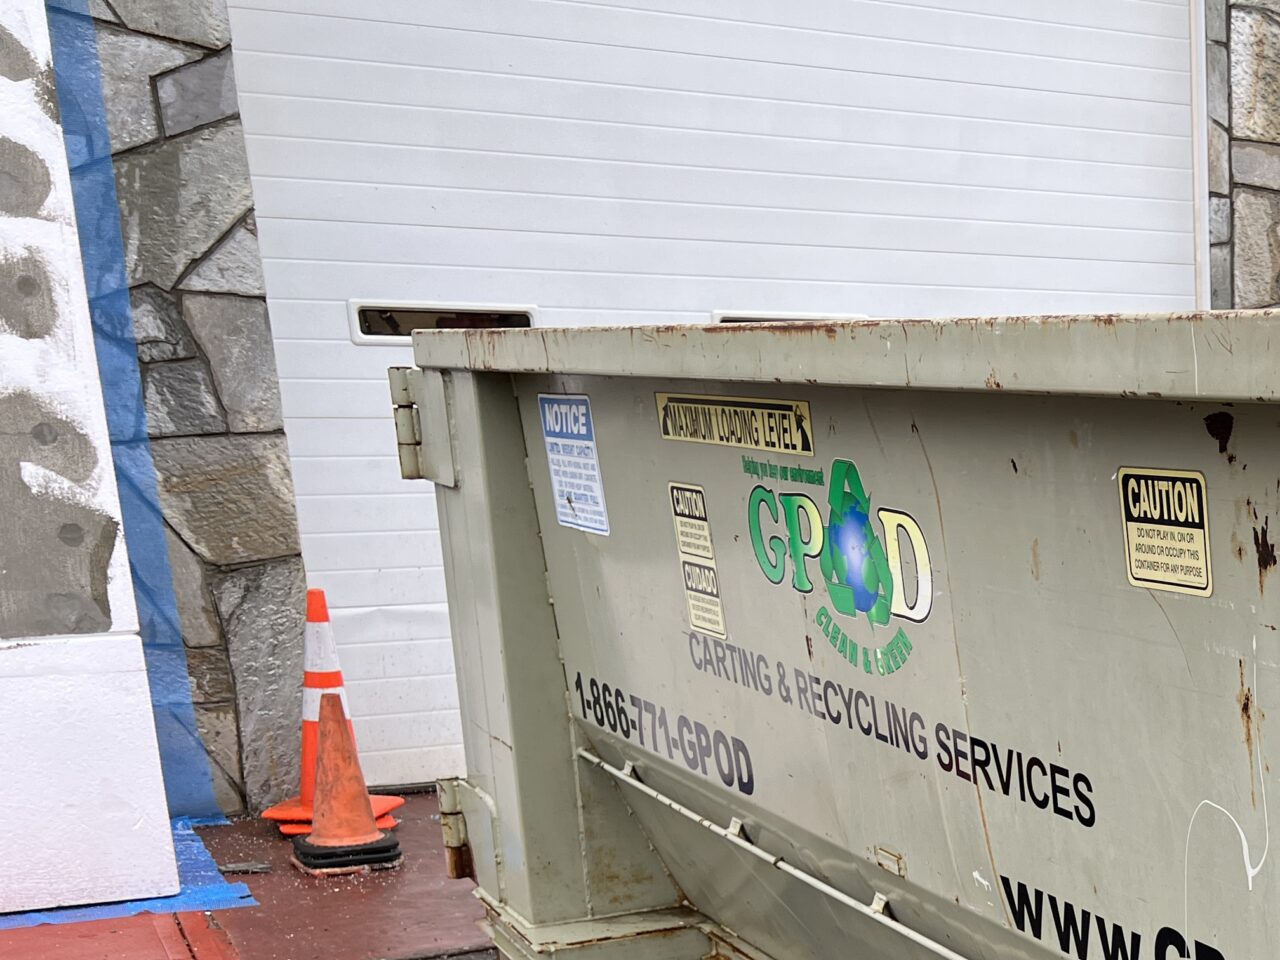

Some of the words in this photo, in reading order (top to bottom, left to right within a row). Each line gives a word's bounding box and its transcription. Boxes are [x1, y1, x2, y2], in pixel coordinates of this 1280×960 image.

[545, 404, 587, 435] NOTICE
[668, 404, 715, 440] MAXIMUM
[715, 407, 760, 446] LOADING
[762, 411, 797, 450] LEVEL
[673, 489, 706, 518] CAUTION
[1127, 478, 1200, 523] CAUTION
[1137, 527, 1145, 538] DO
[1145, 528, 1155, 539] NOT
[1157, 529, 1169, 541] PLAY
[1178, 532, 1186, 542] ON
[1186, 533, 1194, 544] OR
[1135, 543, 1156, 555] AROUND
[1157, 546, 1164, 556] OR
[1165, 546, 1187, 559] OCCUPY
[1187, 549, 1199, 560] THIS
[685, 564, 717, 595] CUIDADO
[1135, 559, 1160, 571] CONTAINER
[1160, 562, 1170, 573] FOR
[1170, 563, 1180, 574] ANY
[1180, 564, 1203, 578] PURPOSE
[815, 606, 857, 668] CLEAN
[863, 647, 873, 675] &
[875, 626, 913, 677] GREEN
[575, 671, 754, 796] 1-866-771-GPOD
[688, 632, 773, 696] CARTING
[776, 661, 793, 705] &
[794, 667, 929, 760] RECYCLING
[935, 722, 1096, 828] SERVICES
